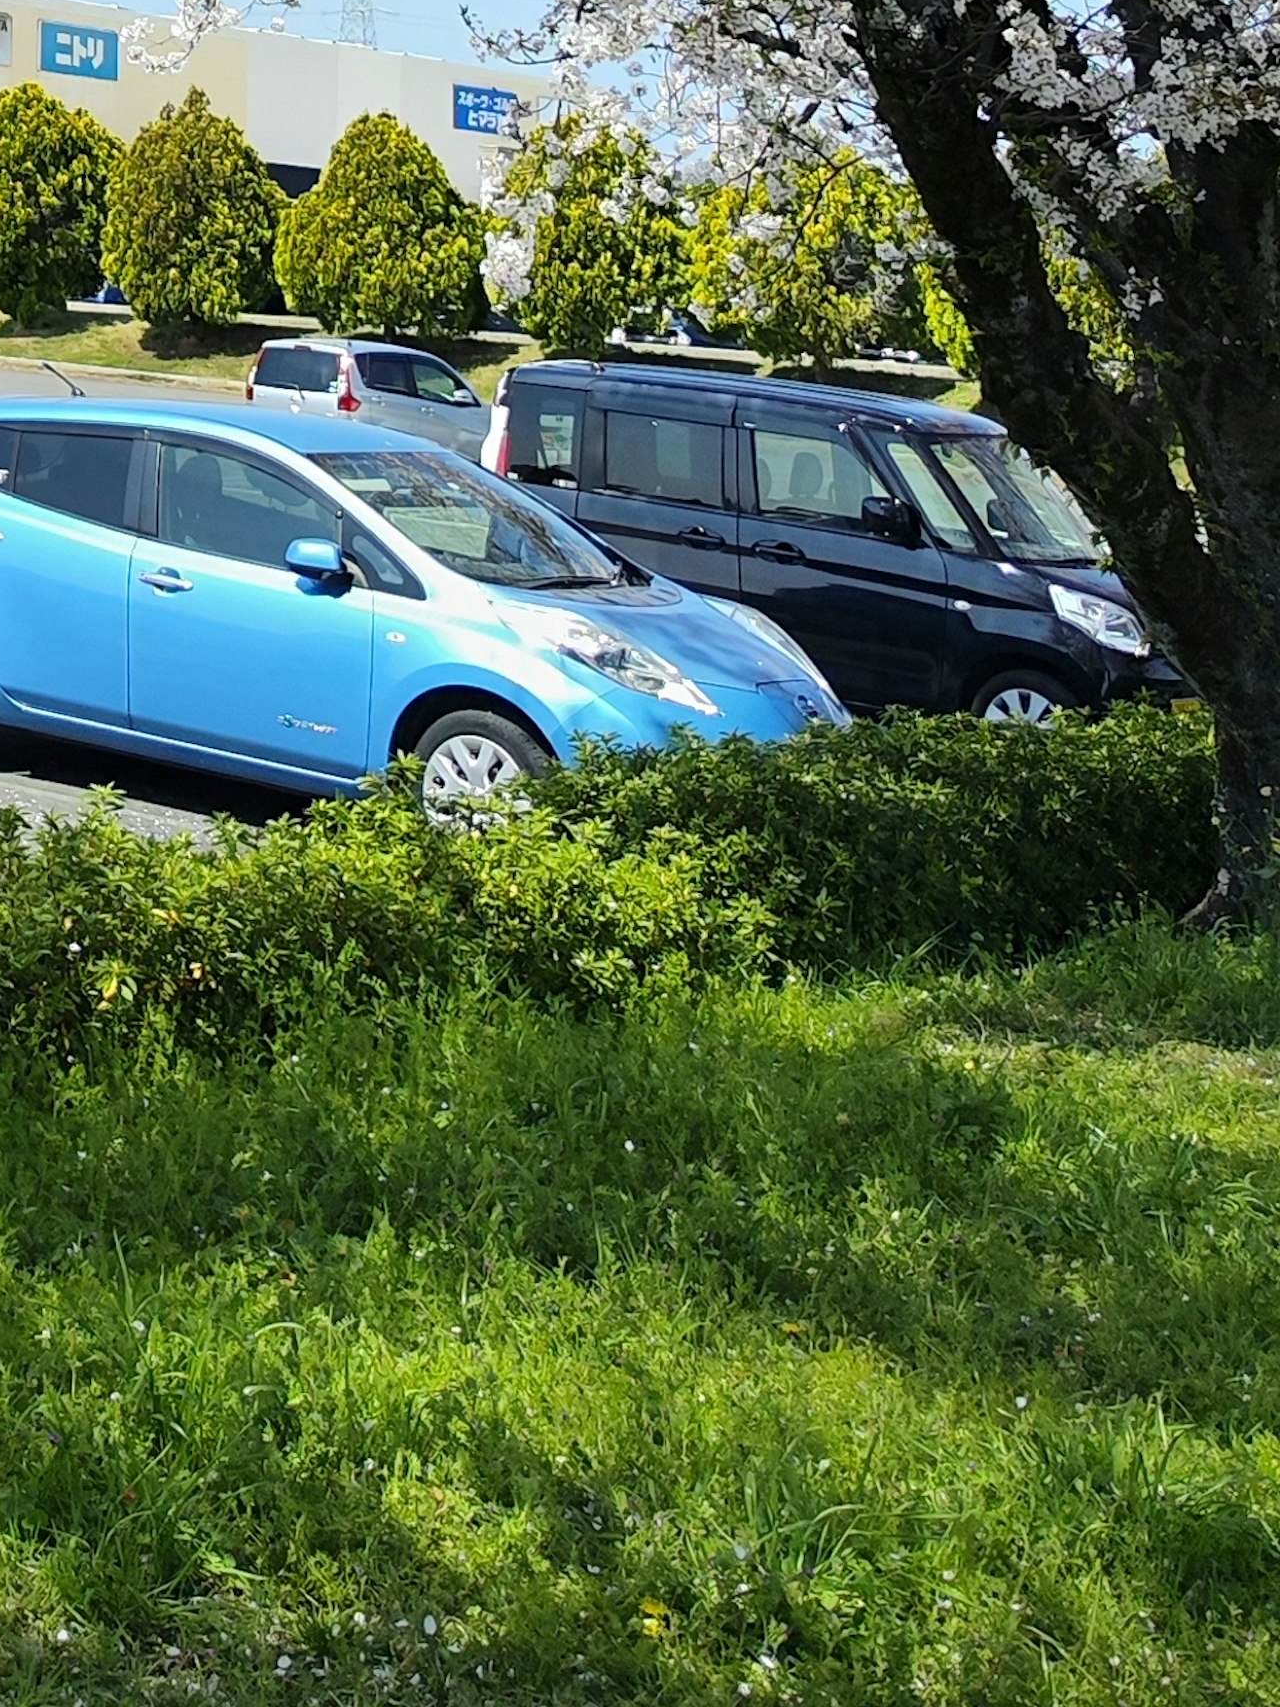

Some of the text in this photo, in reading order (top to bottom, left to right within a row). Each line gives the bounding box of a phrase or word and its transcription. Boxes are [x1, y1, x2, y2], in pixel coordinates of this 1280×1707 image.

[55, 32, 105, 70] ニトリ
[468, 108, 504, 130] ヒマラ
